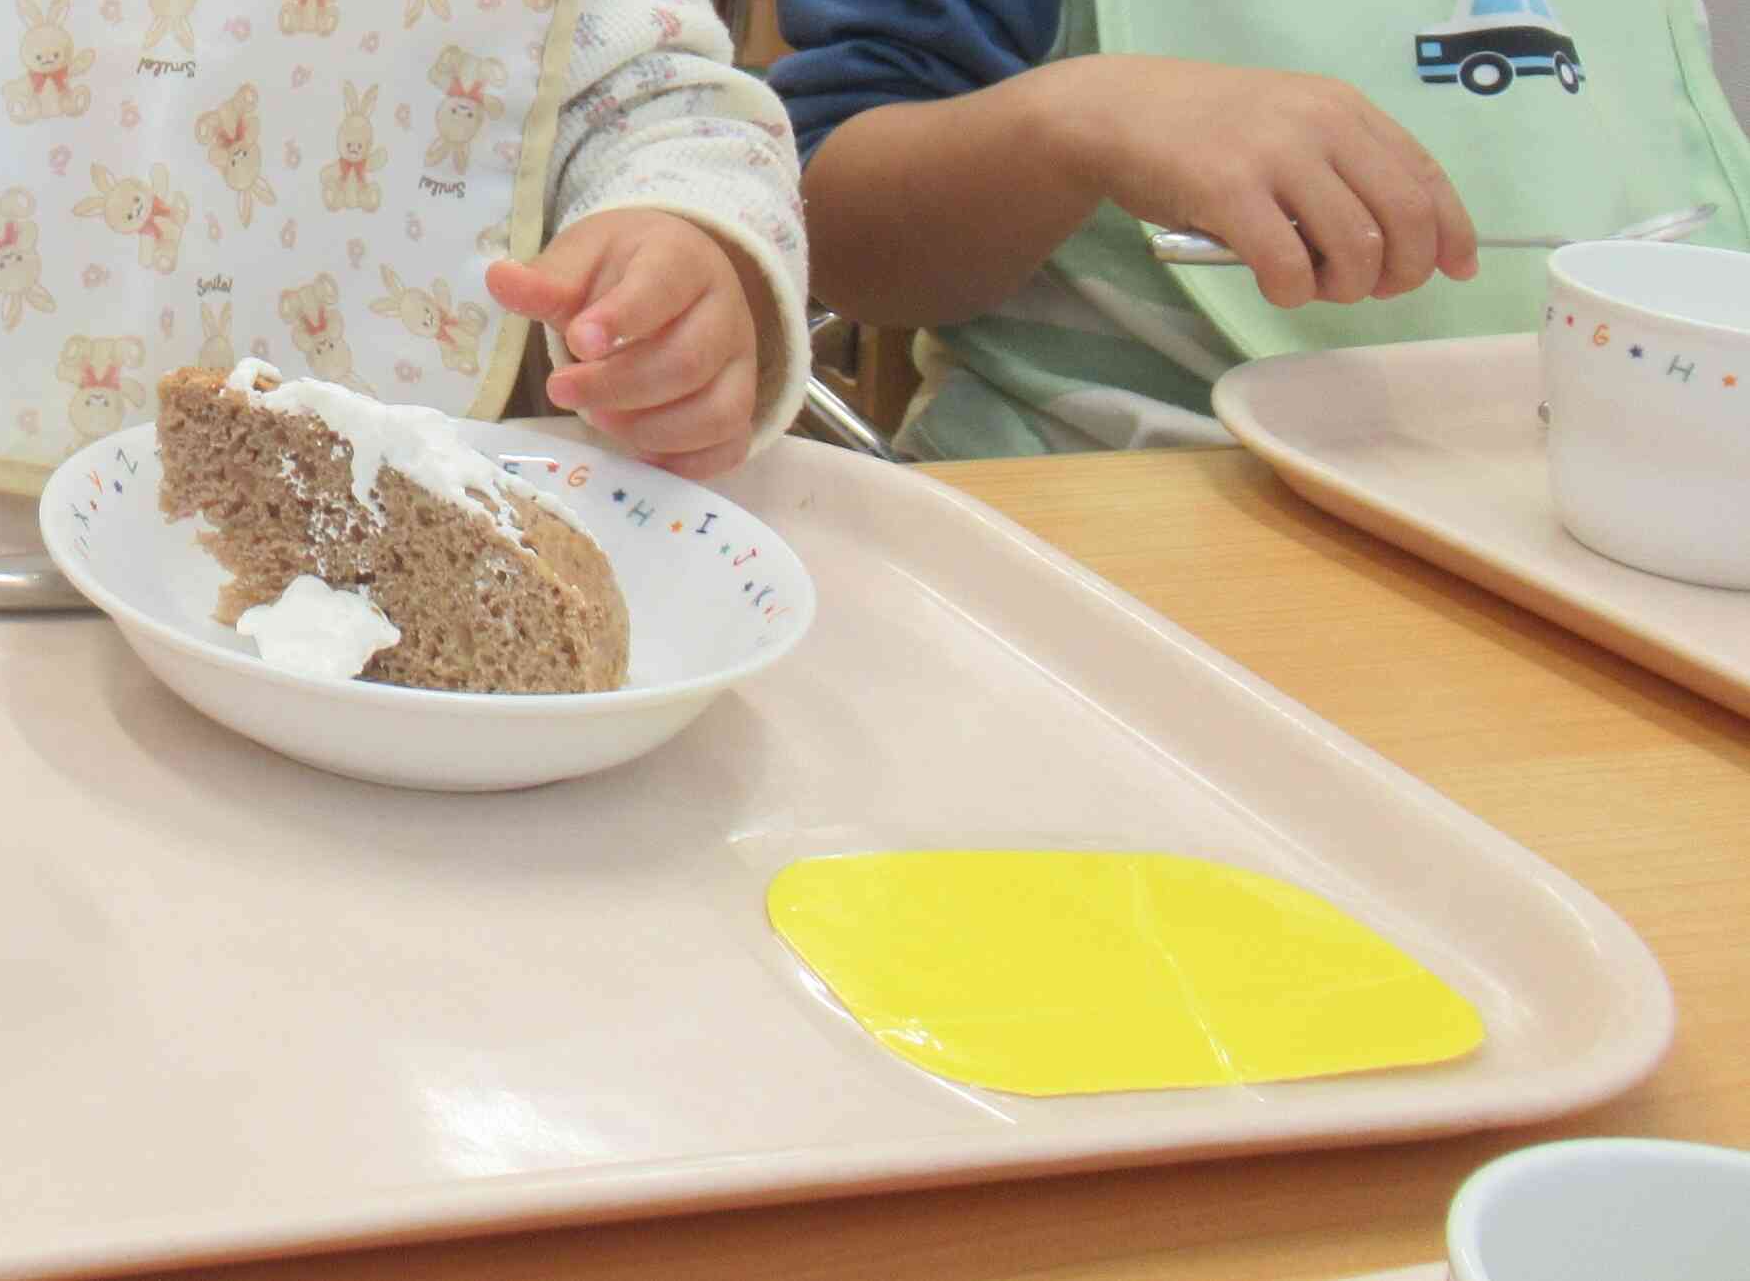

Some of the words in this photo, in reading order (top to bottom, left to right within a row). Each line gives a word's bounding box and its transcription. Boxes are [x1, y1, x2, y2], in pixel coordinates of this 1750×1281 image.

[1666, 355, 1696, 383] H
[568, 463, 590, 487] G
[626, 498, 655, 527] H
